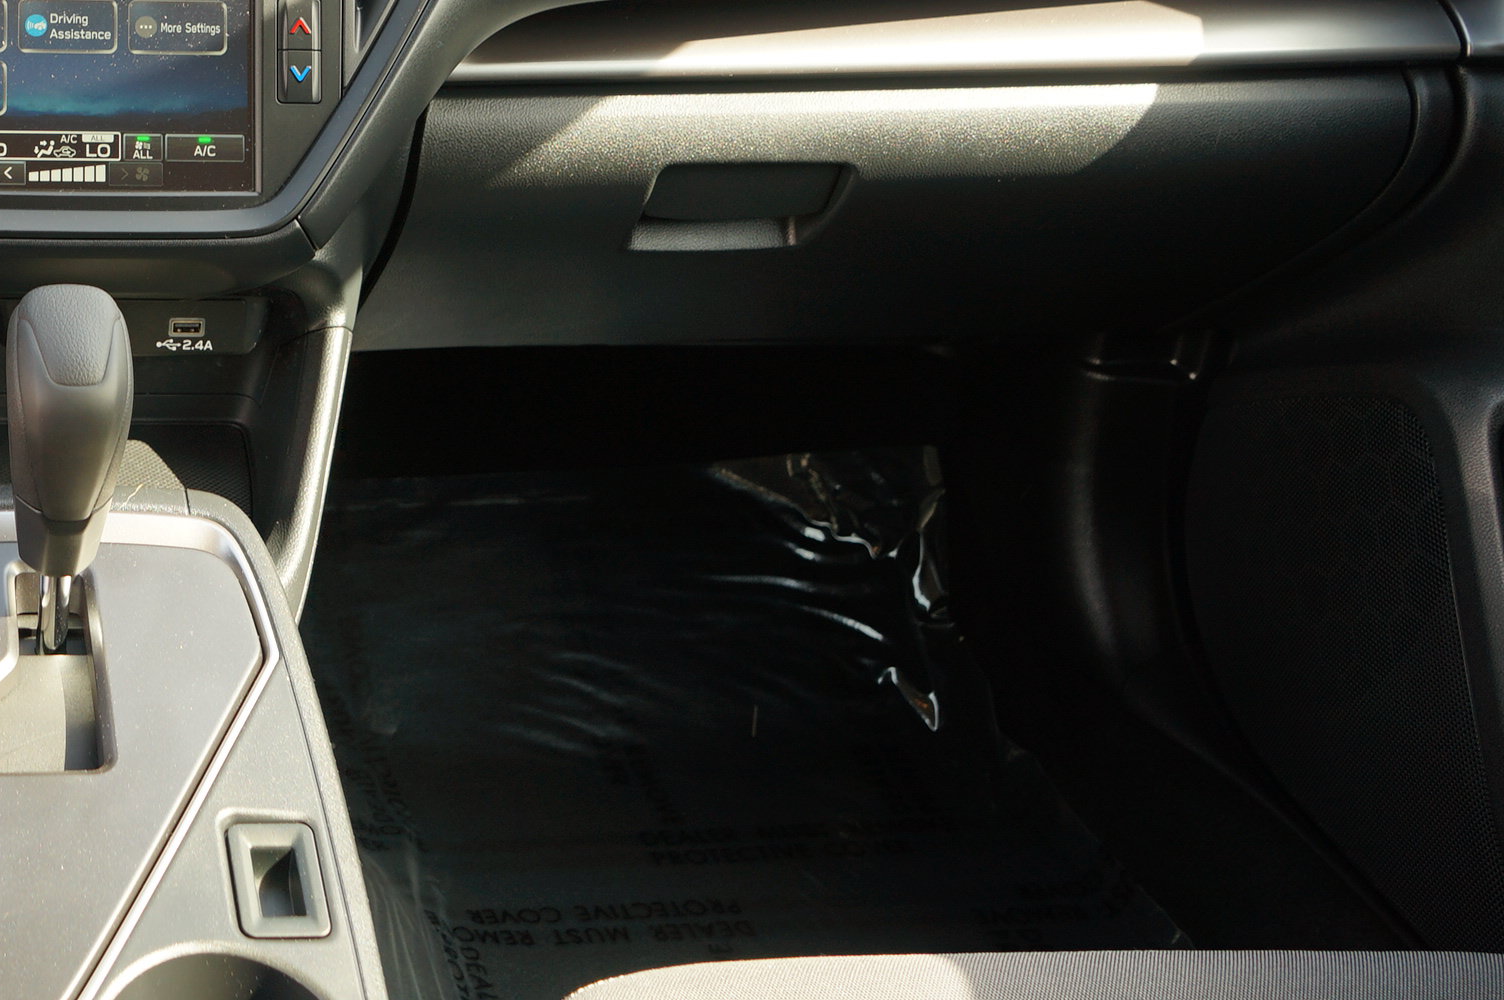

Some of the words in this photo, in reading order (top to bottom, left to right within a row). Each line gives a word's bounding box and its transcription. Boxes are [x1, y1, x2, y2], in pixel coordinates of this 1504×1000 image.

[50, 13, 89, 27] Driving
[50, 28, 112, 41] Assistance
[160, 22, 183, 34] More
[185, 22, 221, 35] Settings
[60, 134, 78, 145] A/C
[85, 144, 111, 158] LO
[132, 147, 153, 160] ALL
[193, 144, 217, 158] A/C
[182, 339, 213, 351] 2.4A
[464, 906, 563, 926] COVER
[574, 898, 742, 924] PROTECTIVE
[452, 925, 534, 947] REMO
[553, 925, 631, 947] MUST
[651, 919, 757, 943] DEALER
